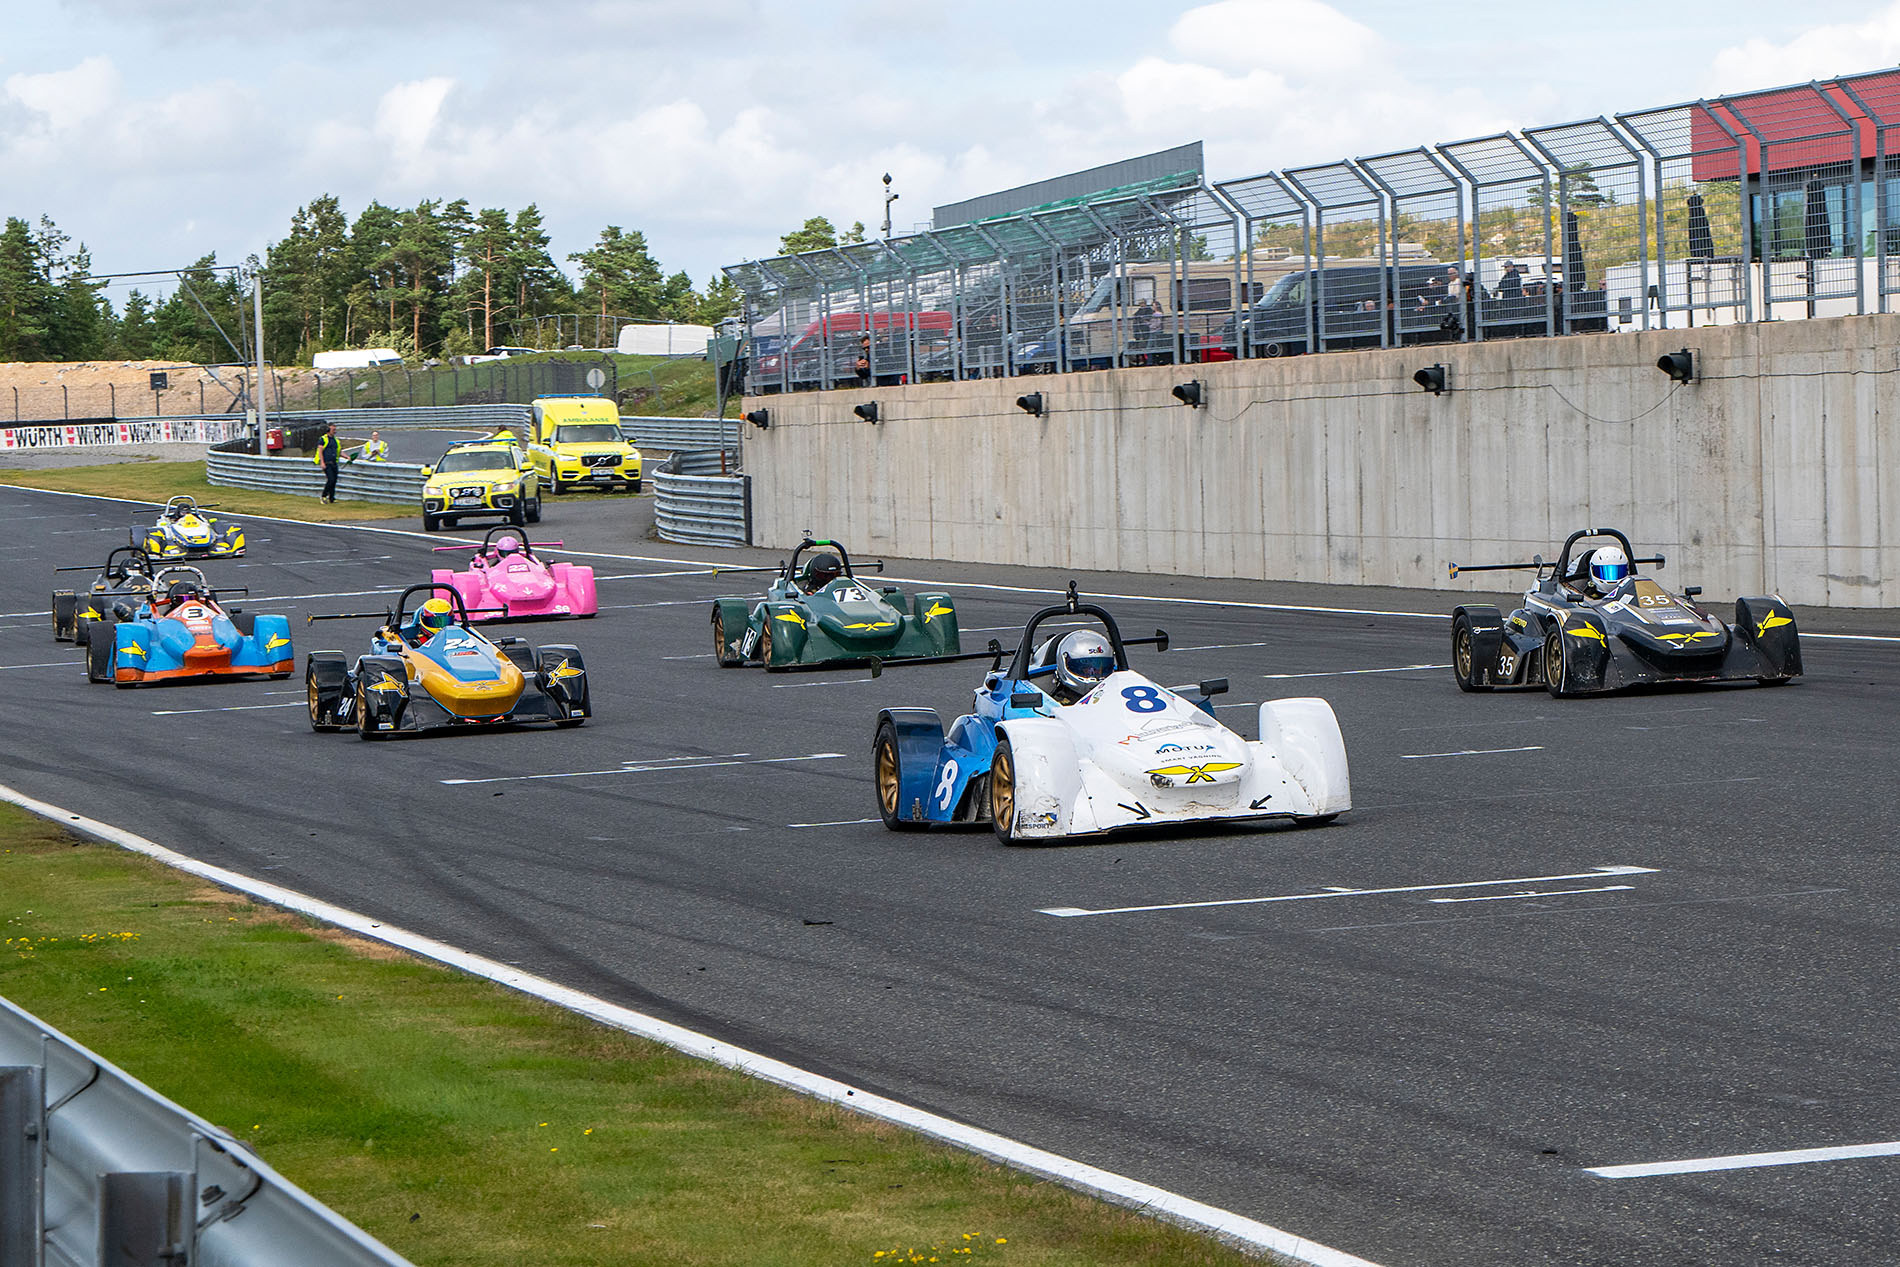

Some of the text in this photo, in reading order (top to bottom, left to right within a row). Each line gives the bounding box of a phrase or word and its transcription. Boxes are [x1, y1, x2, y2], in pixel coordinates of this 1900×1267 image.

[15, 427, 62, 447] WÜRTH
[1640, 594, 1670, 606] 35
[188, 608, 203, 619] 3
[444, 639, 476, 651] 24
[1498, 655, 1514, 676] 35
[337, 697, 353, 717] 24
[1121, 686, 1167, 713] 8
[935, 759, 969, 811] 8
